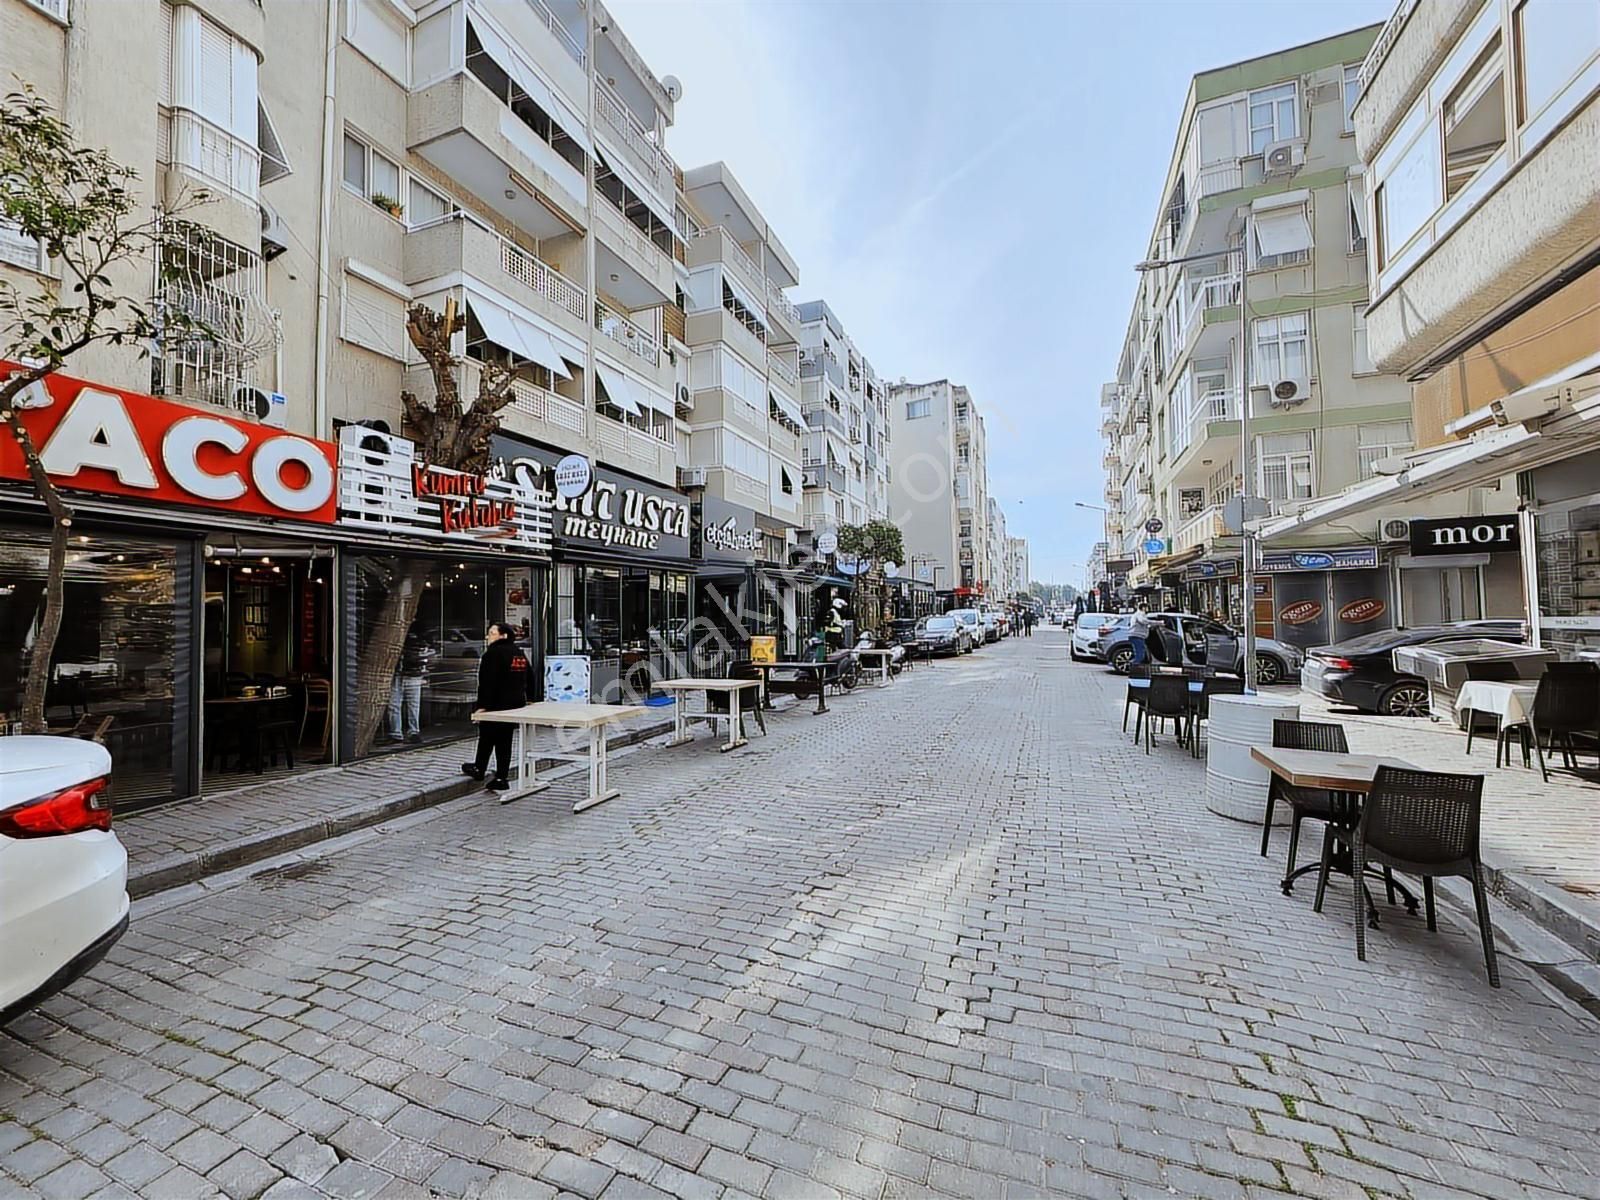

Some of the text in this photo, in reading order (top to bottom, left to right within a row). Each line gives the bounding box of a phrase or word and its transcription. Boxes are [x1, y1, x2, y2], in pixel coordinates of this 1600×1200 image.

[624, 489, 689, 538] USTA
[1431, 524, 1514, 545] mor
[1282, 603, 1313, 620] egem
[1342, 601, 1375, 618] egem
